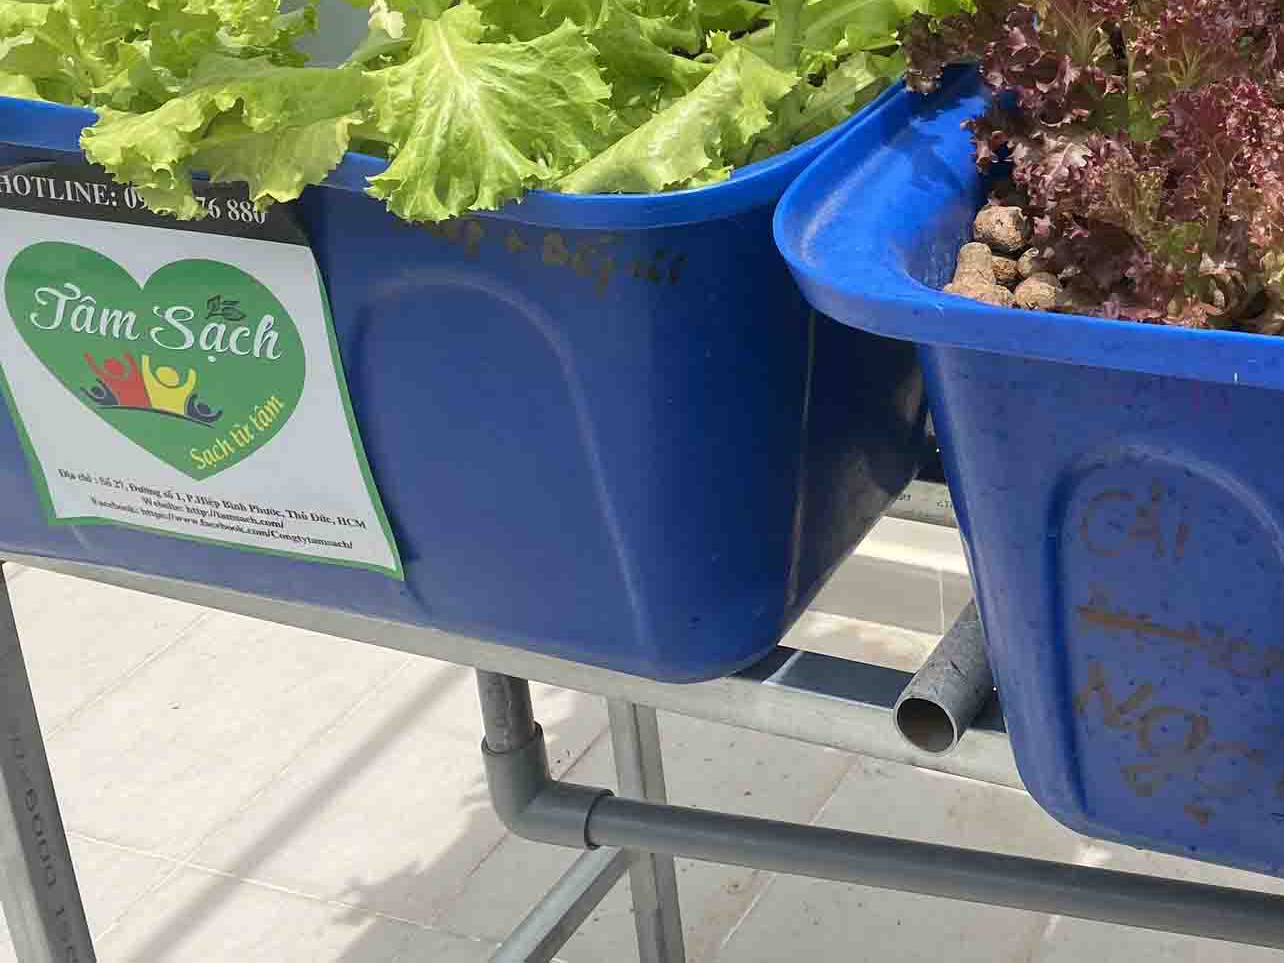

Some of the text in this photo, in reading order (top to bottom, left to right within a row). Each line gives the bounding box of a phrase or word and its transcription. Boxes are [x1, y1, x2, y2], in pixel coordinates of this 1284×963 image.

[0, 173, 118, 207] HOTLINE:
[30, 283, 282, 362] Tâm Sạch
[191, 437, 235, 469] Sạch
[249, 396, 284, 431] tâm
